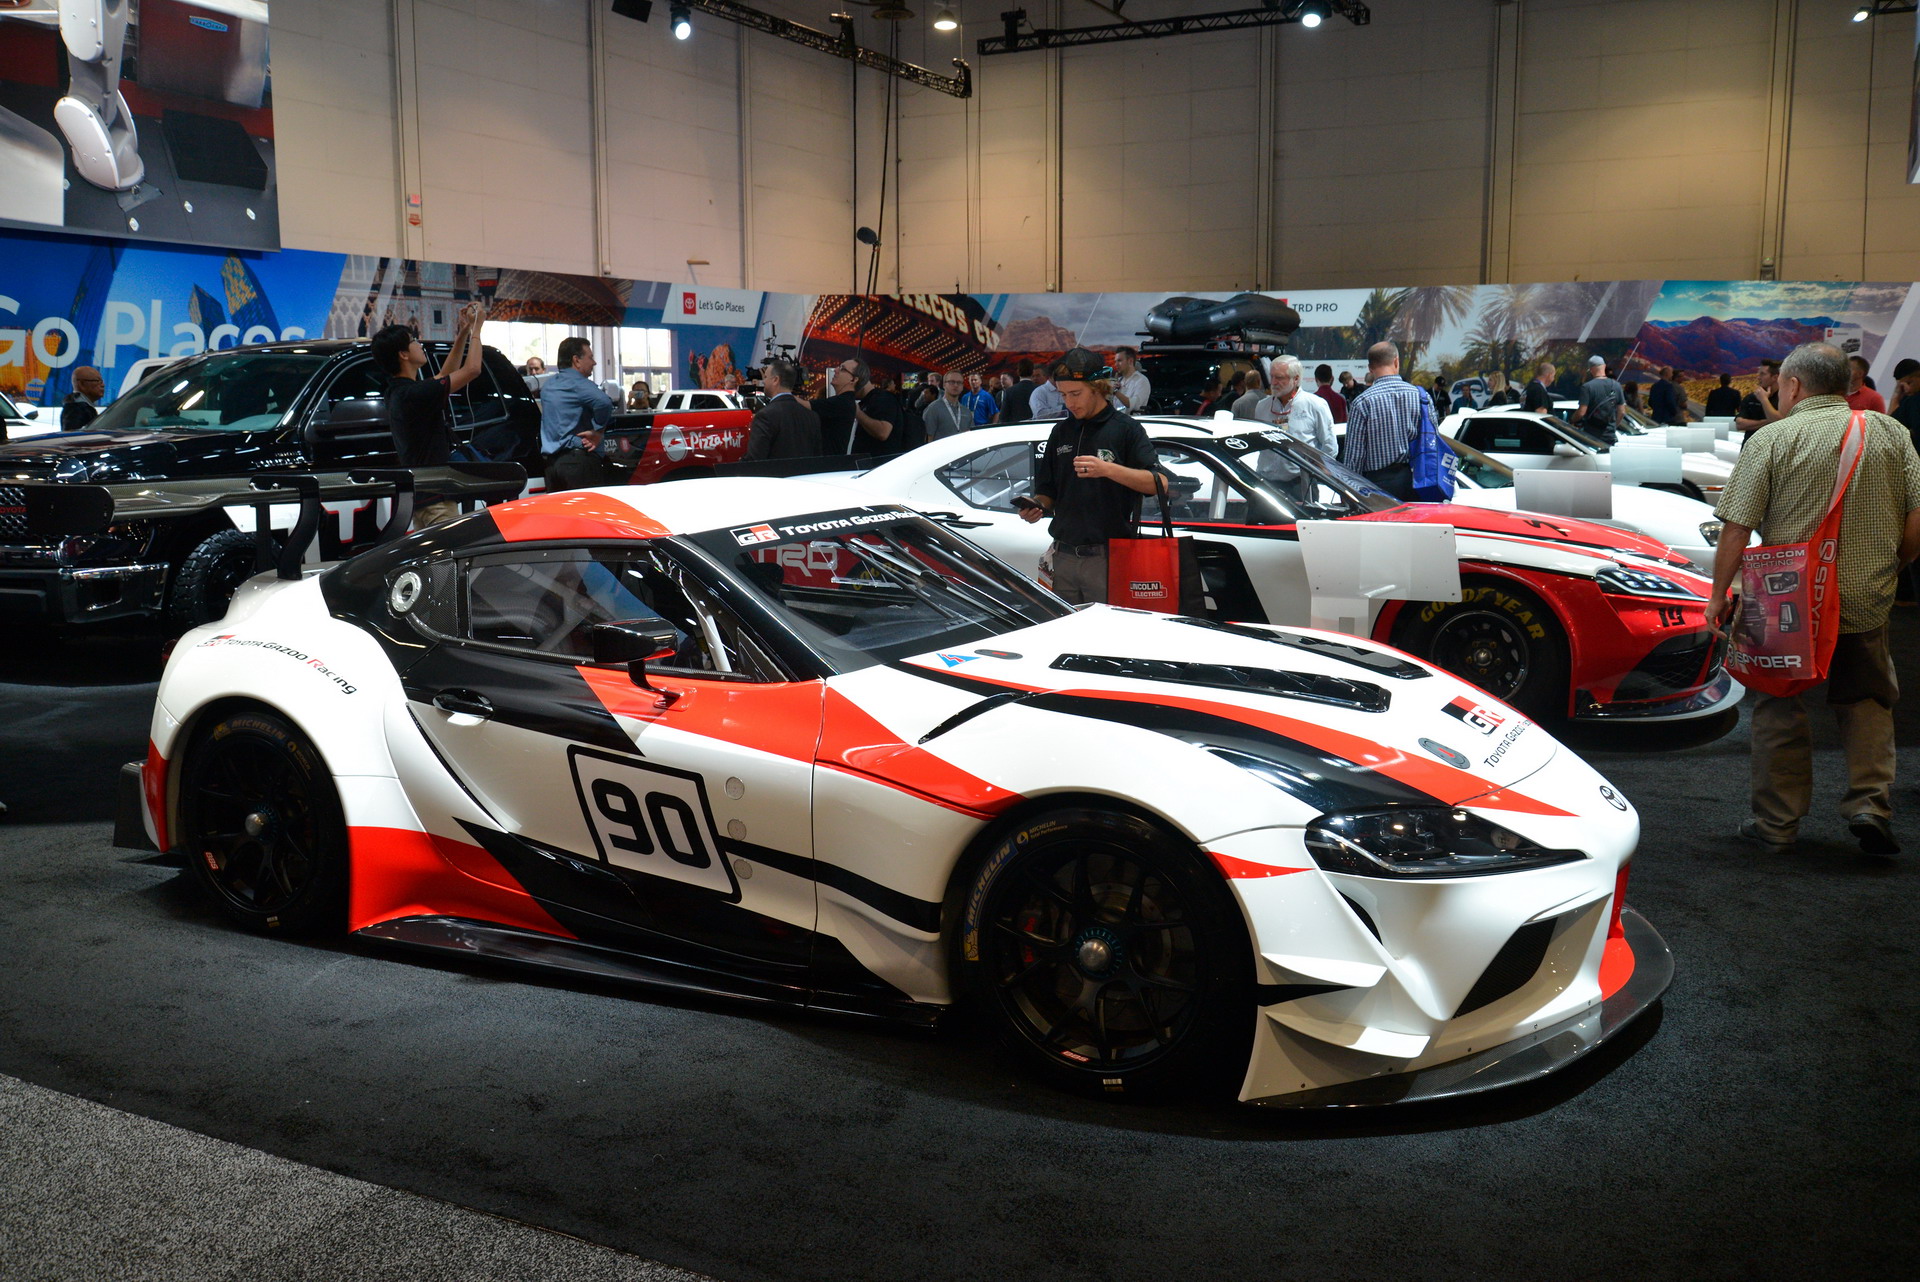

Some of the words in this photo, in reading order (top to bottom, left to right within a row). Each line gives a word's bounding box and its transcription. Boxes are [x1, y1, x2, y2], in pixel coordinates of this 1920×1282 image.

[698, 300, 714, 310] Let's
[714, 301, 725, 311] Go
[725, 302, 745, 313] Places
[888, 294, 969, 334] IRCUS
[1292, 303, 1313, 312] TRD
[1315, 303, 1338, 312] PRO
[689, 431, 723, 453] Pizza
[723, 430, 745, 448] Hut
[737, 529, 779, 545] GR
[779, 519, 852, 536] TOYOTA
[850, 513, 896, 525] GAZOO
[1420, 587, 1546, 640] GODYEAR
[1657, 606, 1686, 627] 19
[262, 642, 308, 660] GAZOO
[306, 658, 357, 694] Racing
[1736, 651, 1802, 668] SPYDER
[232, 719, 287, 740] MICHELIN
[1483, 739, 1512, 768] TOYOTA
[591, 778, 712, 869] 90
[968, 843, 1010, 926] MICHELIN
